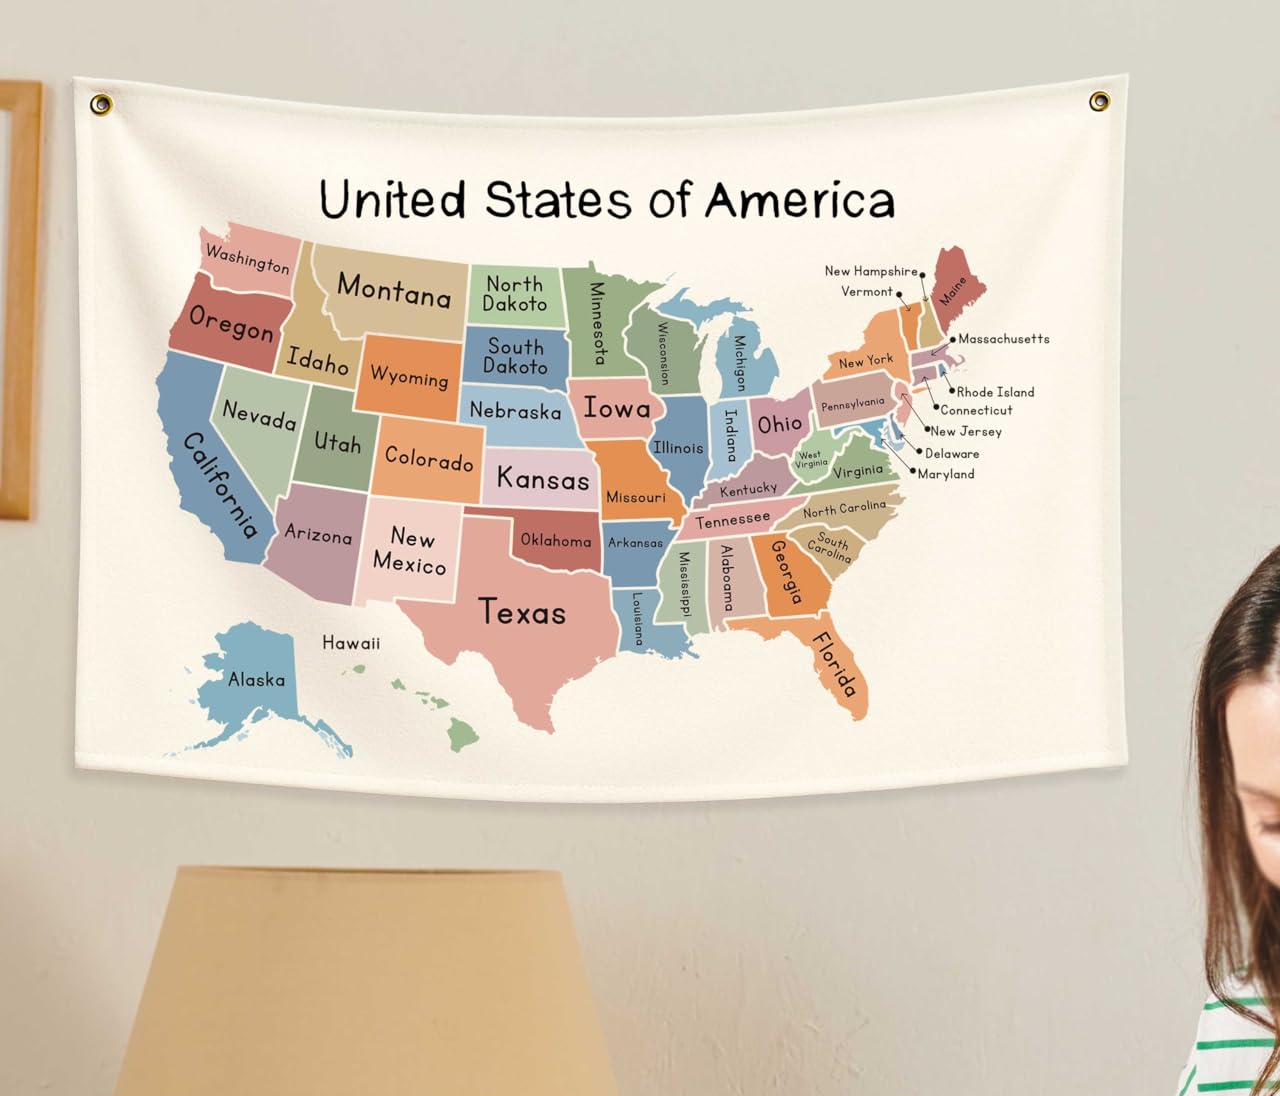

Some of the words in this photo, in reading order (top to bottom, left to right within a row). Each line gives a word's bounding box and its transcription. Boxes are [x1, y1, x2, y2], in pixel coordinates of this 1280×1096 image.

[320, 178, 465, 220] United
[486, 180, 632, 220] States
[649, 178, 694, 219] of
[704, 179, 895, 219] America
[206, 242, 290, 276] Washington
[825, 265, 850, 276] New
[853, 265, 919, 279] Hampshire
[337, 271, 451, 310] Montana
[487, 275, 543, 293] North
[841, 285, 893, 297] Vermont
[939, 277, 967, 306] Maine
[189, 304, 273, 343] Oregon
[590, 282, 609, 365] Minnesota
[488, 338, 543, 355] South
[958, 333, 1050, 344] Massachusetts
[286, 345, 349, 376] Idaho
[839, 358, 864, 369] New
[866, 353, 894, 366] York
[370, 364, 449, 392] Wyoming
[957, 386, 993, 398] Rhode
[997, 386, 1035, 398] Island
[222, 399, 297, 432] Nevada
[470, 400, 561, 421] Nebraska
[584, 395, 650, 418] Iowa
[821, 398, 885, 412] Pennsylvania
[940, 404, 1013, 416] Connecticut
[758, 415, 802, 434] Ohio
[931, 426, 955, 437] New
[959, 426, 1003, 440] Jersey
[315, 430, 361, 454] Utah
[725, 409, 739, 462] Indiana
[653, 440, 704, 454] Illinois
[799, 450, 821, 460] West
[925, 447, 980, 459] Delaware
[385, 445, 474, 473] Colorado
[795, 457, 828, 469] Virginia
[497, 465, 589, 491] Kansas
[833, 465, 883, 480] Virginia
[918, 468, 975, 482] Maryland
[184, 432, 258, 540] California
[606, 490, 666, 503] Missouri
[719, 481, 777, 498] Kentucky
[803, 505, 836, 519] North
[838, 499, 887, 514] Carolina
[695, 512, 770, 530] Tennessee
[284, 522, 352, 546] Arizona
[391, 525, 435, 549] New
[520, 532, 592, 548] Oklahoma
[608, 536, 663, 548] Arkansas
[817, 531, 849, 552] South
[373, 549, 447, 576] Mexico
[807, 541, 852, 564] Carolina
[771, 540, 802, 605] Georgia
[679, 551, 692, 617] Mississippi
[477, 596, 566, 625] Texas
[632, 592, 643, 646] Louisiana
[323, 634, 380, 650] Hawaii
[812, 631, 856, 698] Florida
[228, 671, 285, 687] Alaska
